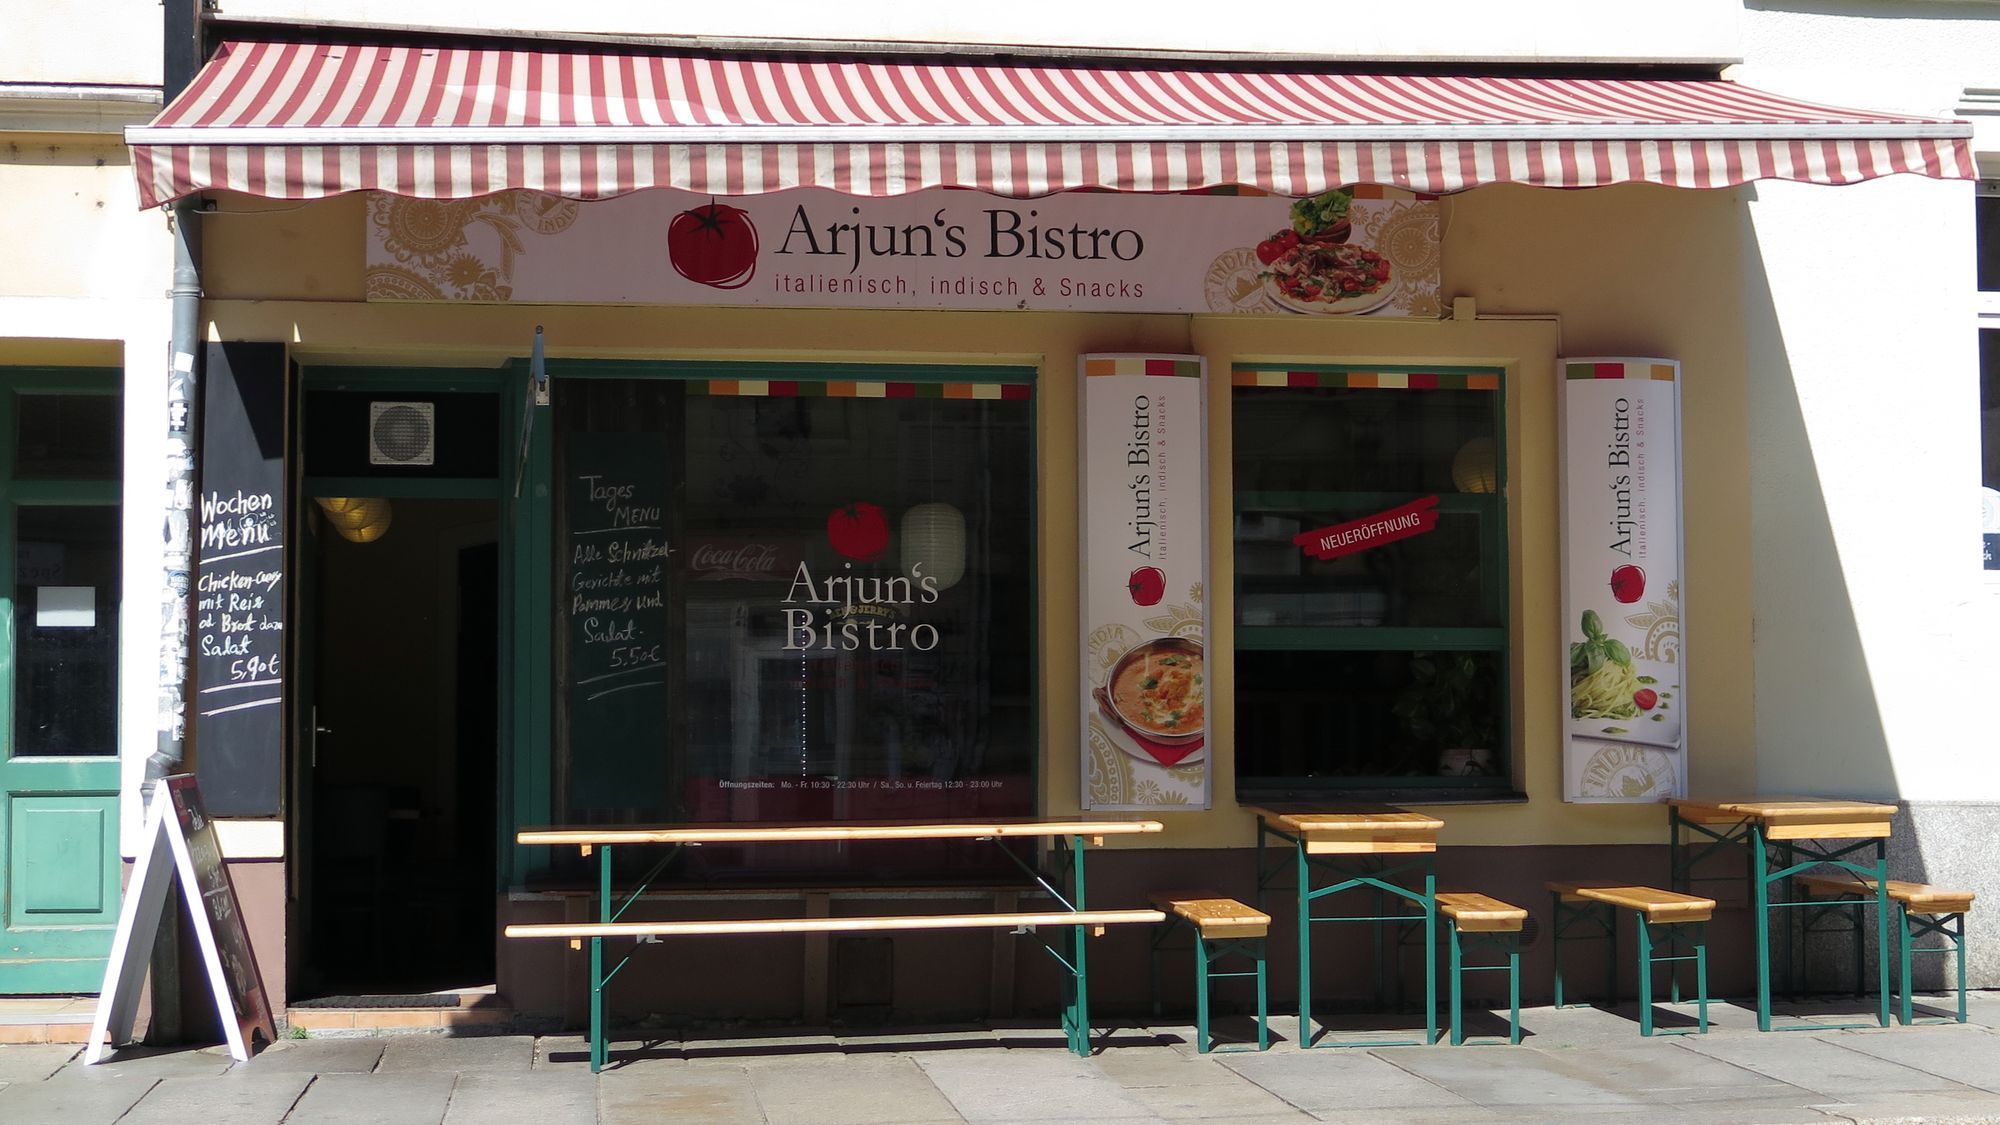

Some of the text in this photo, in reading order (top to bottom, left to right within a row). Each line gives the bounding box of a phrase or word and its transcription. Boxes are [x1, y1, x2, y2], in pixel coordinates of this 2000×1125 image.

[774, 204, 1144, 274] Arjun's Bistro
[775, 274, 1144, 298] italienisch, indisch & Snacks
[1635, 398, 1645, 436] Snacks
[1127, 395, 1158, 560] Arjun's Bistro
[1157, 396, 1168, 560] italienisch, indisch & Snacks
[1608, 398, 1639, 559] Arjun's Bistro
[1636, 453, 1646, 492] indisch
[201, 489, 273, 524] Wochen
[579, 475, 635, 512] Tages
[1320, 512, 1420, 551] NEUERÖFFNUNG
[1637, 497, 1647, 559] italienisch,
[574, 544, 602, 564] Alle
[692, 543, 779, 572] Coca-Cola
[637, 565, 661, 585] mit
[780, 560, 940, 619] Arjun's
[199, 593, 265, 613] mit Reis
[221, 612, 257, 633] Brot
[780, 608, 940, 651] Bistro
[202, 634, 253, 656] Salat
[719, 780, 775, 790] Öffnungszeiten:
[781, 781, 793, 789] Mo.
[811, 781, 830, 789] 10:30
[837, 781, 857, 789] 22:30
[858, 781, 870, 789] Uhr
[915, 781, 943, 790] Feiertag
[944, 781, 964, 789] 12:30
[970, 780, 990, 788] 23:00
[991, 780, 1003, 788] Uhr
